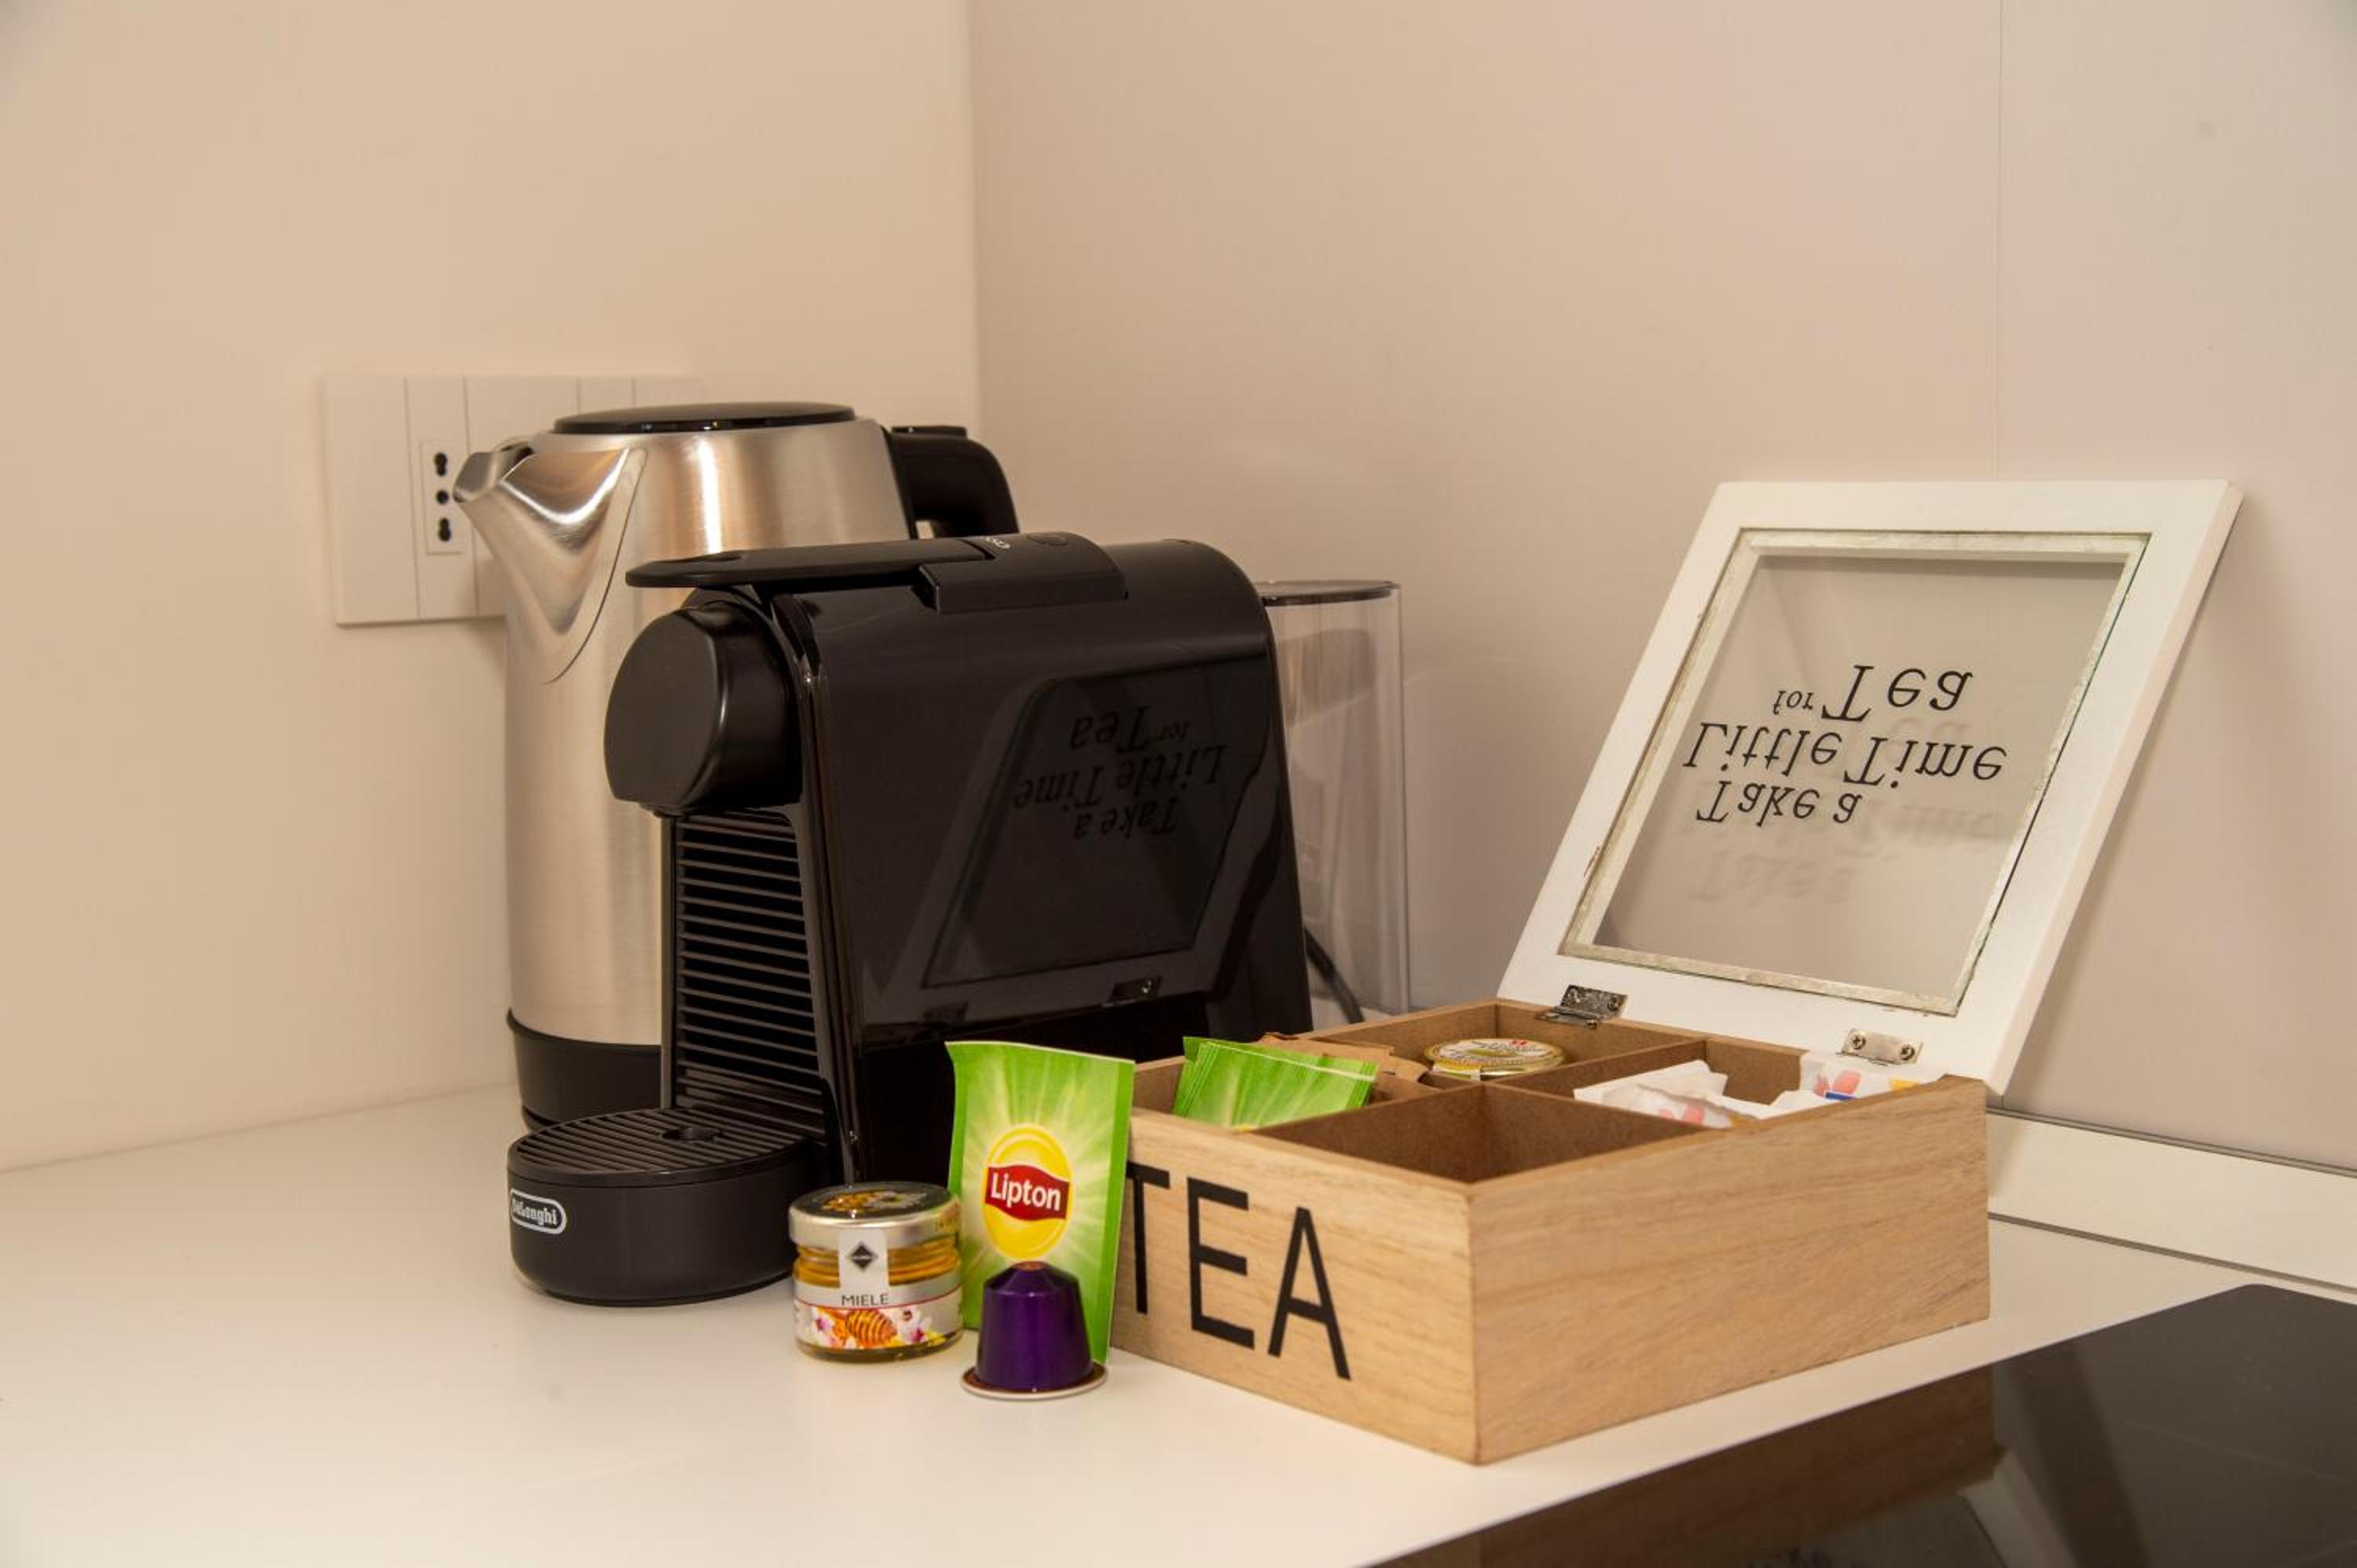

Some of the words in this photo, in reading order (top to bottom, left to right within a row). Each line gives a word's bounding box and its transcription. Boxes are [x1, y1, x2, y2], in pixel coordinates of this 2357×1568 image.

[1069, 705, 1153, 754] Tea
[1014, 764, 1105, 812] Time
[1117, 744, 1230, 796] Little
[1072, 813, 1092, 840] a
[1100, 796, 1178, 839] Take
[991, 1173, 1061, 1211] Lipton
[1127, 1162, 1351, 1381] TEA
[841, 1294, 889, 1306] MIELE
